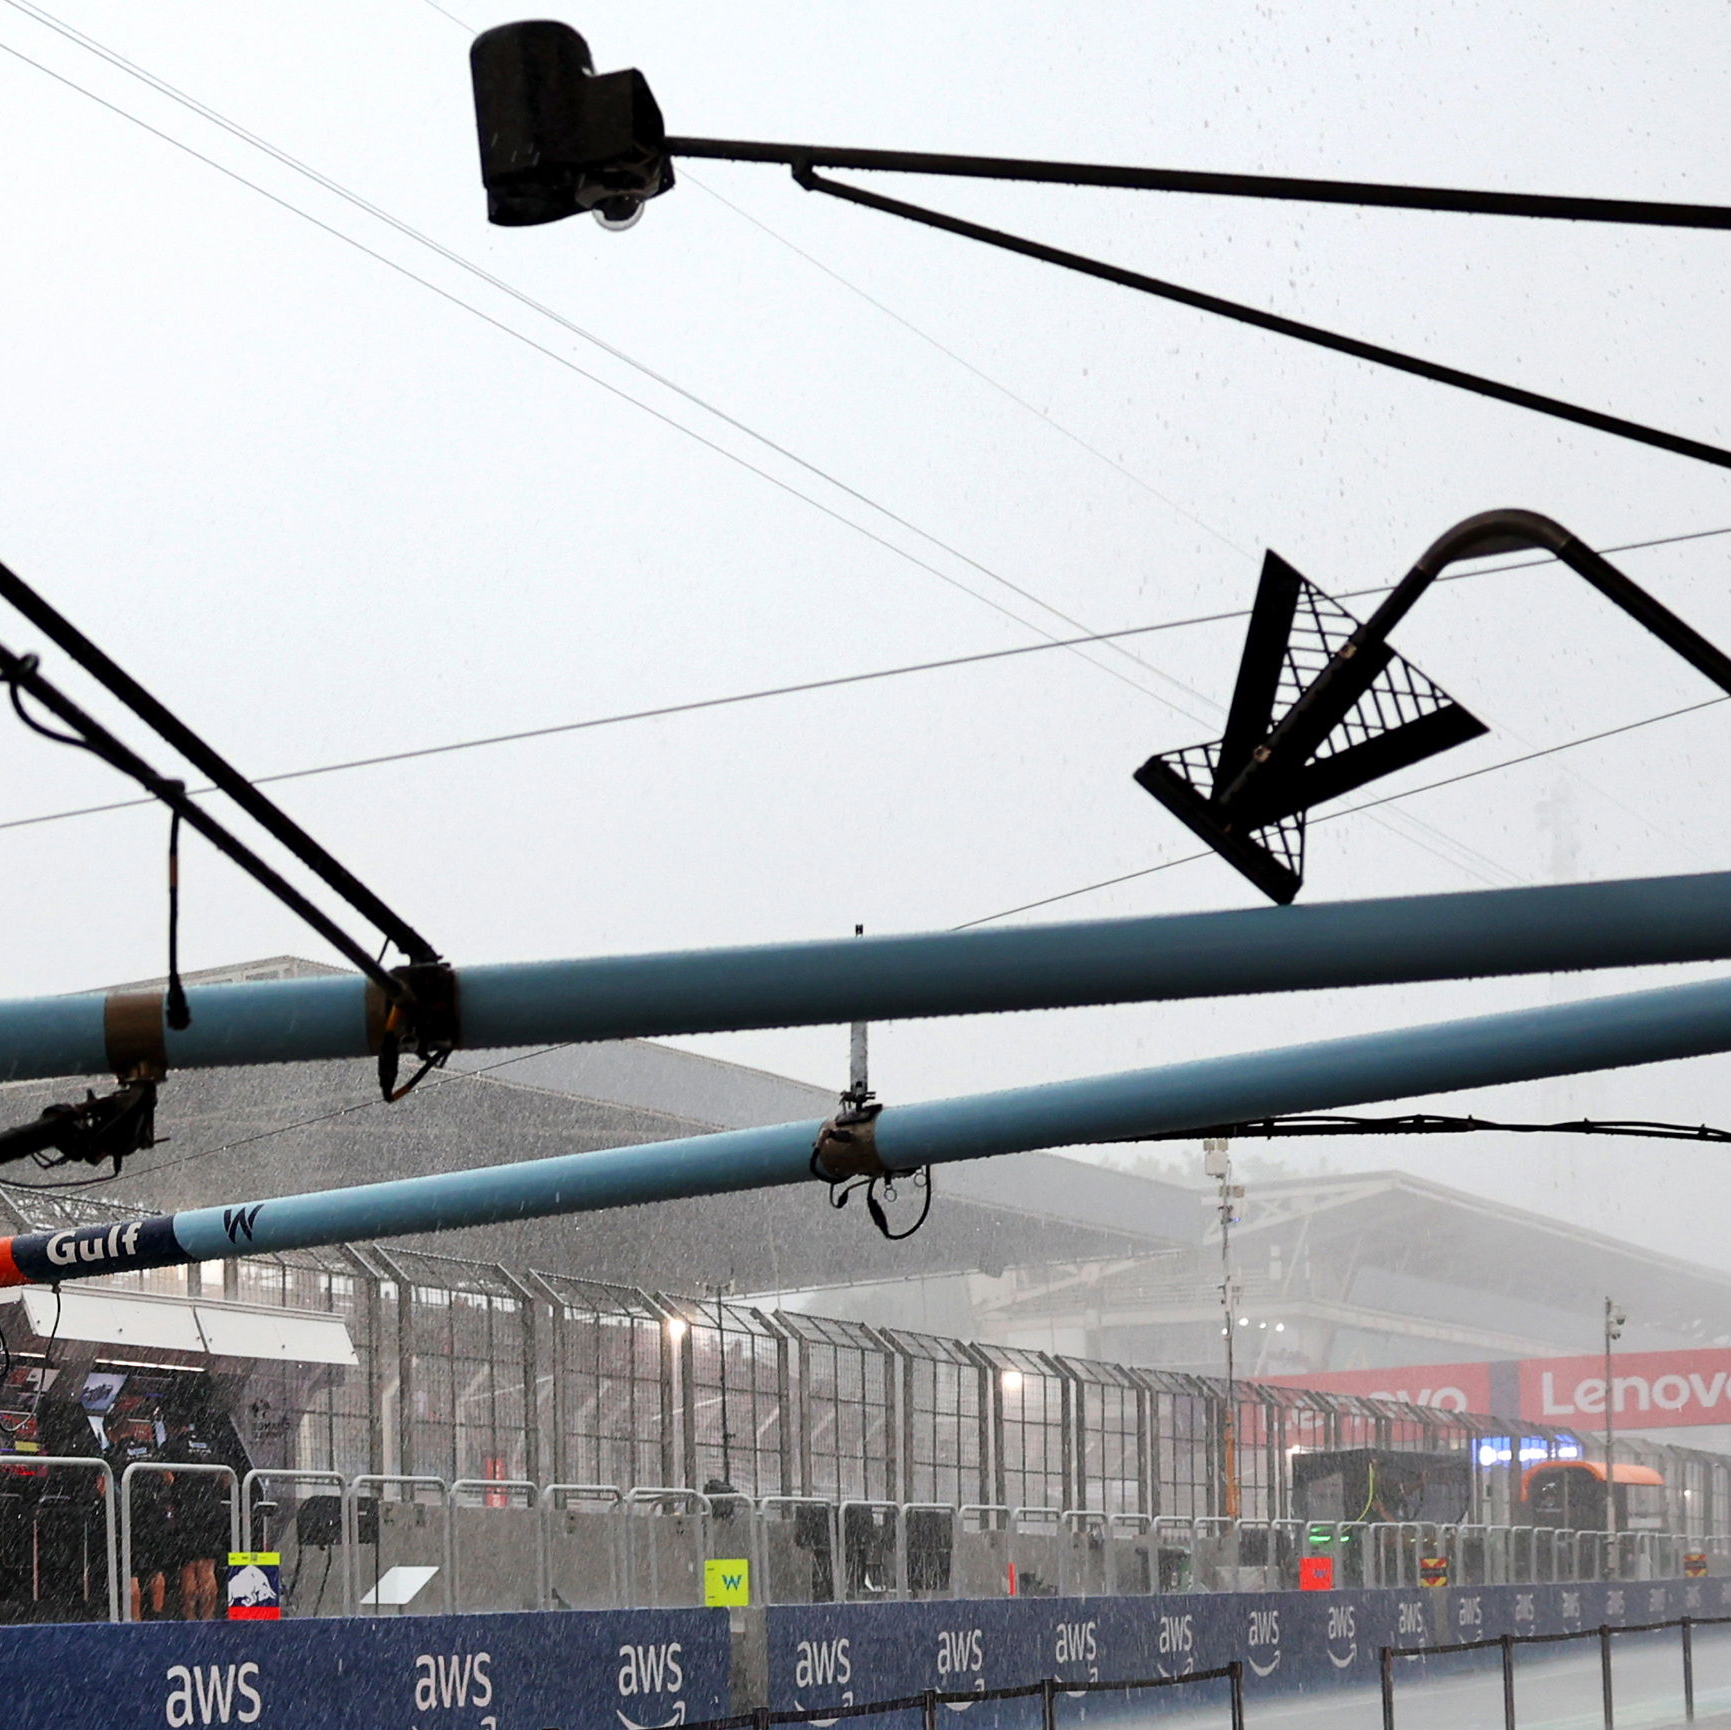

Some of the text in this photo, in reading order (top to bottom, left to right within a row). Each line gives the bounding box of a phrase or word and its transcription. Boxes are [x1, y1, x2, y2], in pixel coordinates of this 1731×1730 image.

[46, 1221, 143, 1266] Gulf
[1055, 1621, 1096, 1664] aws
[1158, 1613, 1192, 1654] aws
[1248, 1605, 1280, 1646] aws
[1328, 1605, 1356, 1640] aws
[619, 1641, 683, 1696] aws
[796, 1638, 851, 1688] aws
[937, 1627, 983, 1674] aws
[166, 1661, 261, 1728] aws
[415, 1651, 492, 1711] aws
